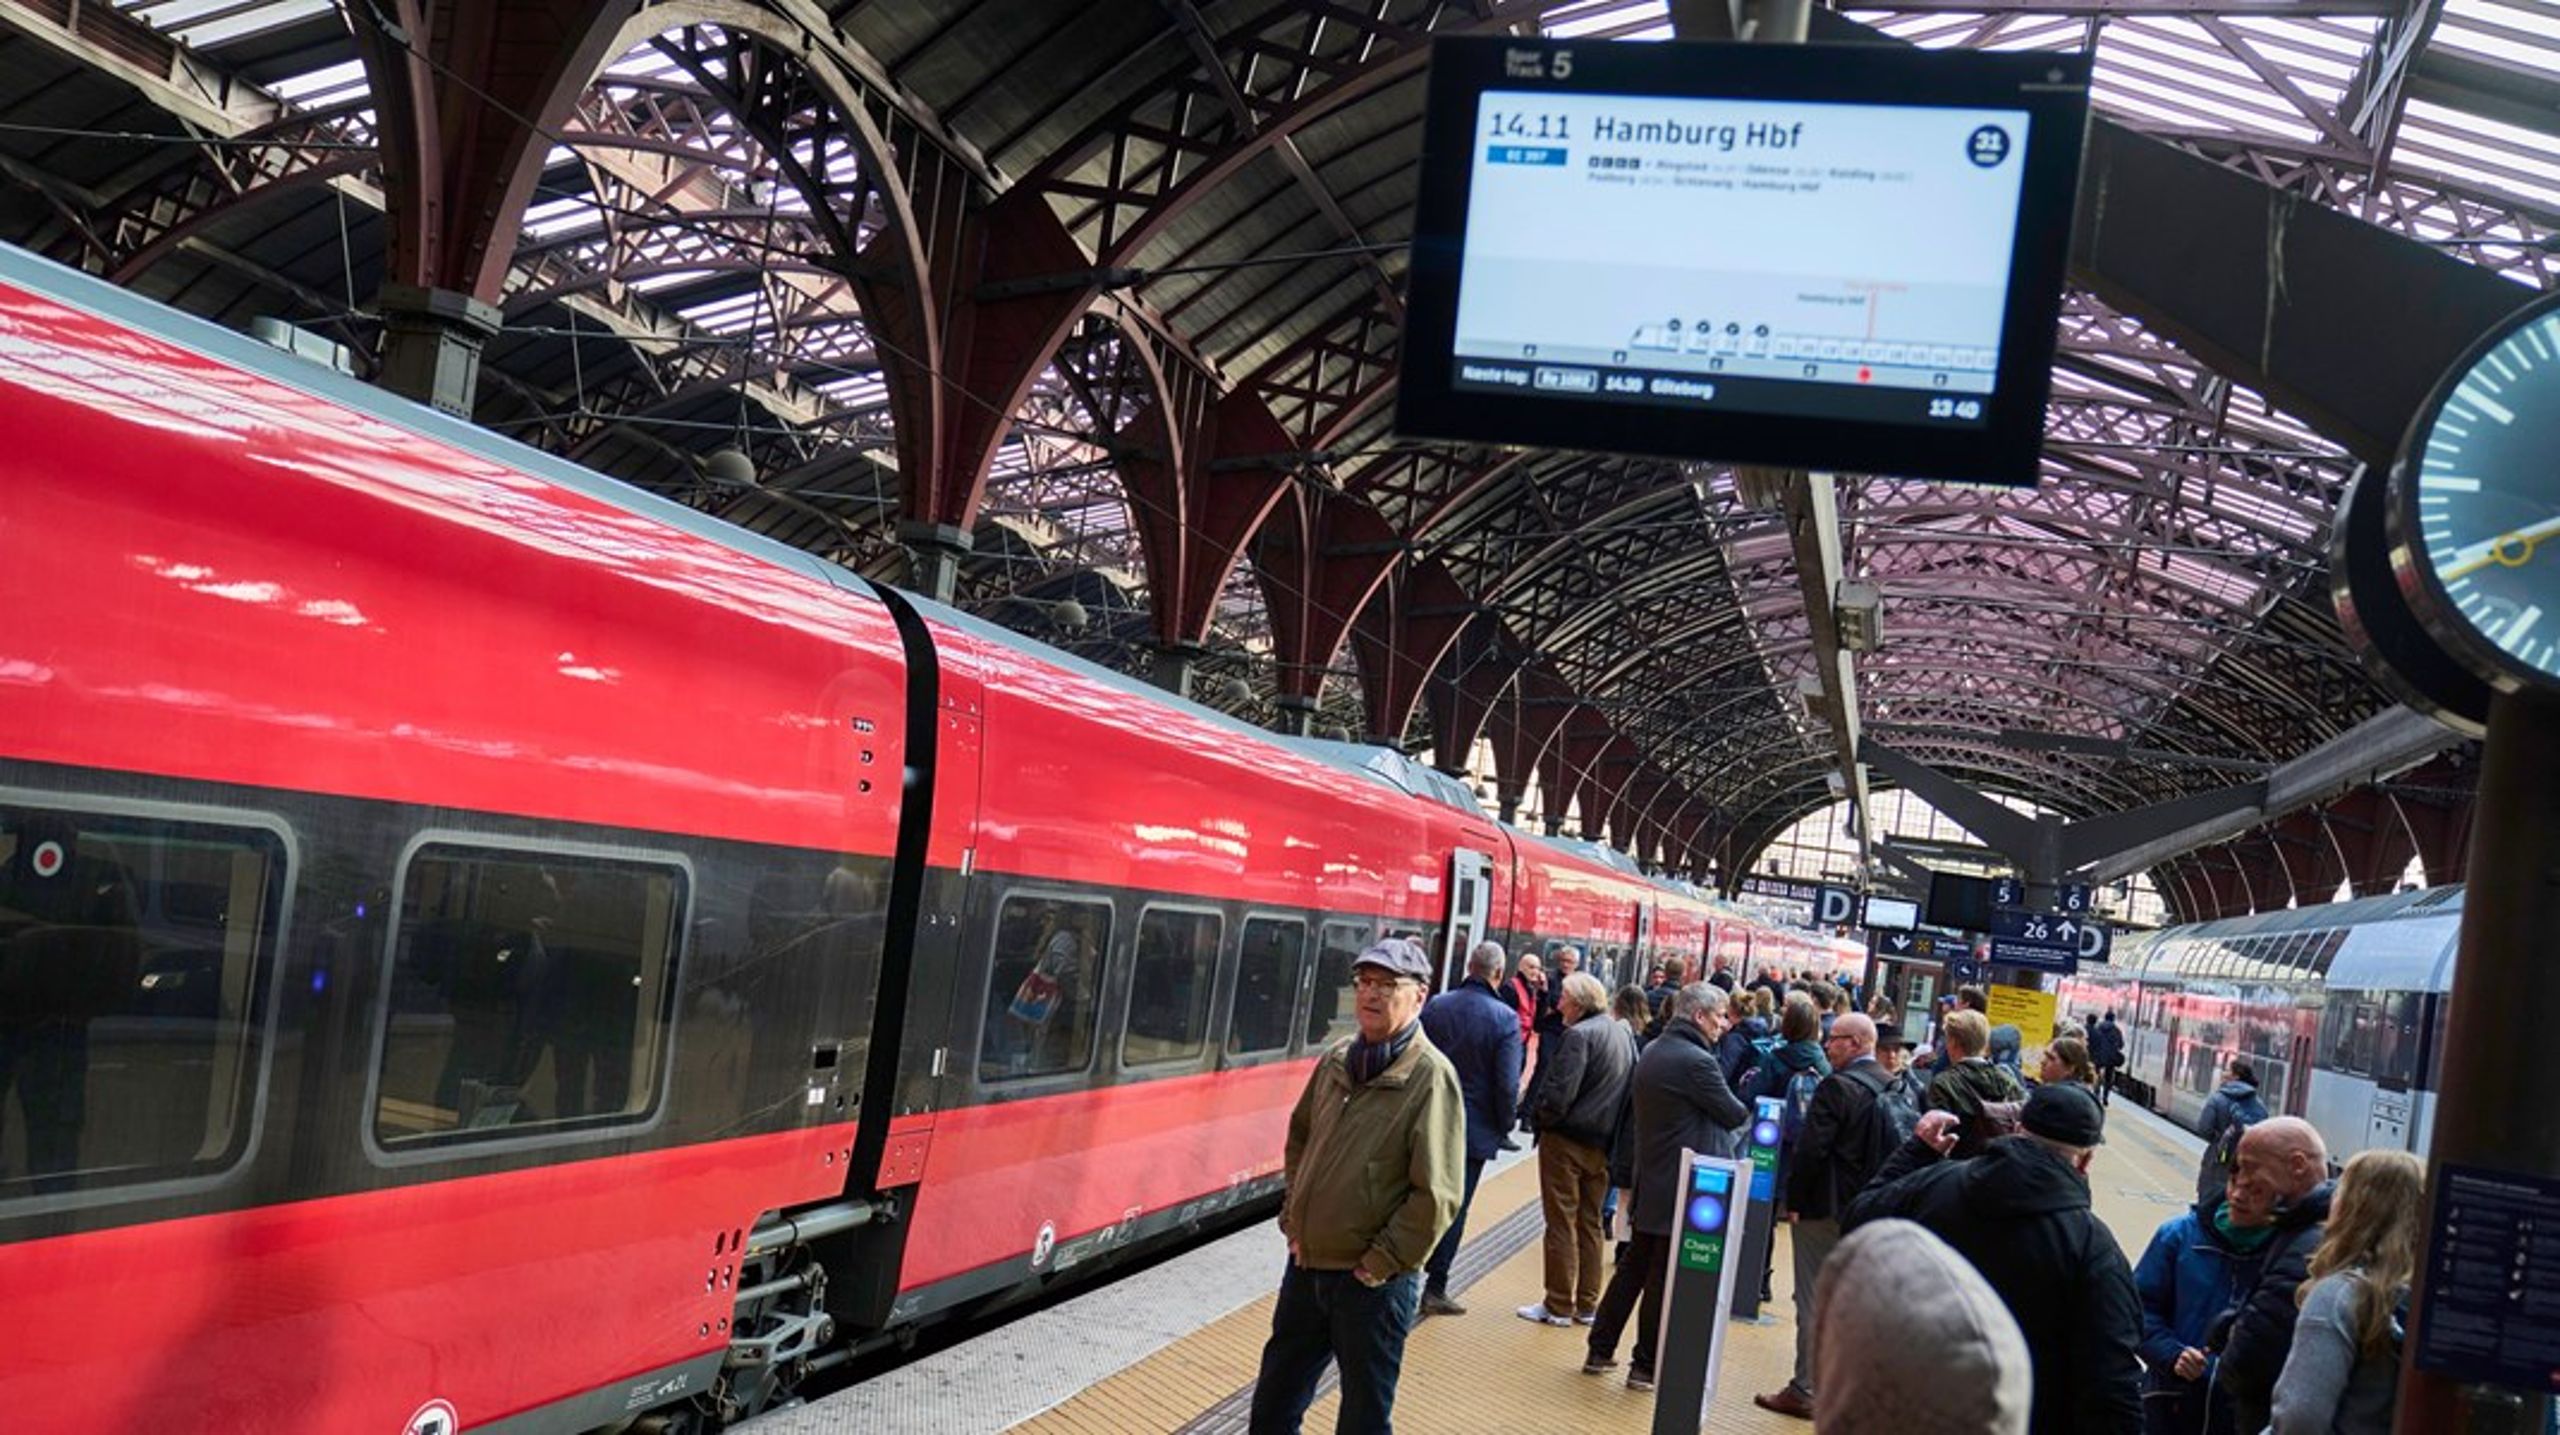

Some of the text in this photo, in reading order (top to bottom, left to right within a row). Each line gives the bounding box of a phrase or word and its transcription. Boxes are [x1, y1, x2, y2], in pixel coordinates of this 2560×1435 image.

[1506, 50, 1573, 80] Track 5
[1489, 112, 1804, 151] 14.11 Hamburg Hbf
[1974, 131, 2003, 151] 31
[1998, 887, 2010, 903] 5
[2068, 893, 2080, 909] 6
[1821, 889, 1850, 922] D
[2023, 922, 2048, 940] 26
[2079, 924, 2103, 957] D
[1683, 1237, 1721, 1253] Check
[1691, 1252, 1710, 1263] ind
